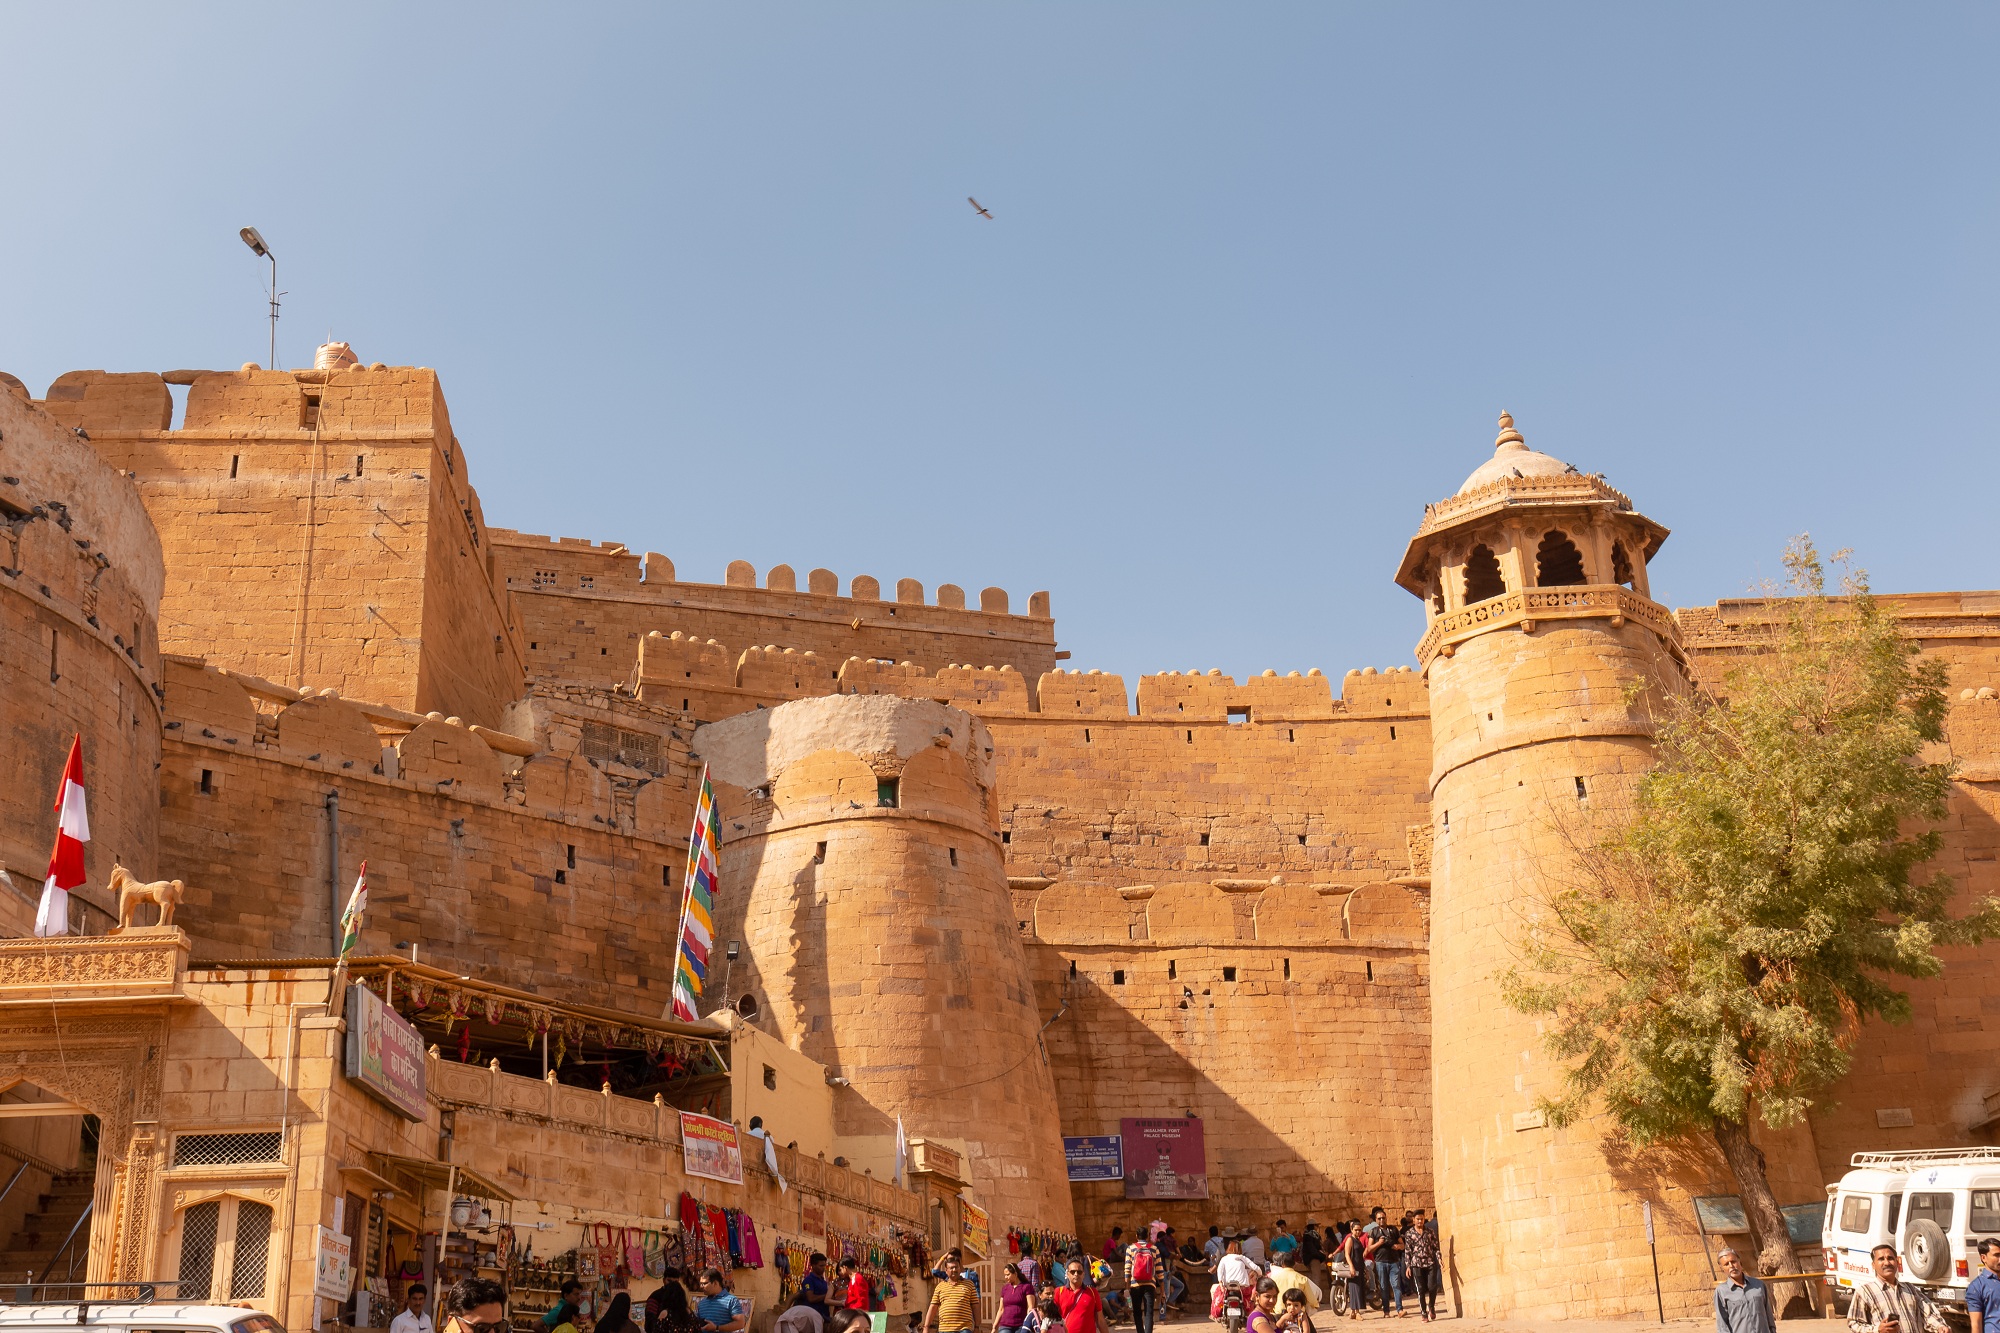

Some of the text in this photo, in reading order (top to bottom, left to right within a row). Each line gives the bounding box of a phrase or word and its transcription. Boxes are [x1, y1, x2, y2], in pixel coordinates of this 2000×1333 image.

[382, 1012, 424, 1064] बाबा रामदेव जी
[391, 1050, 400, 1076] का
[321, 1233, 349, 1257] शीतल जल
[1844, 1262, 1869, 1274] Mahindra
